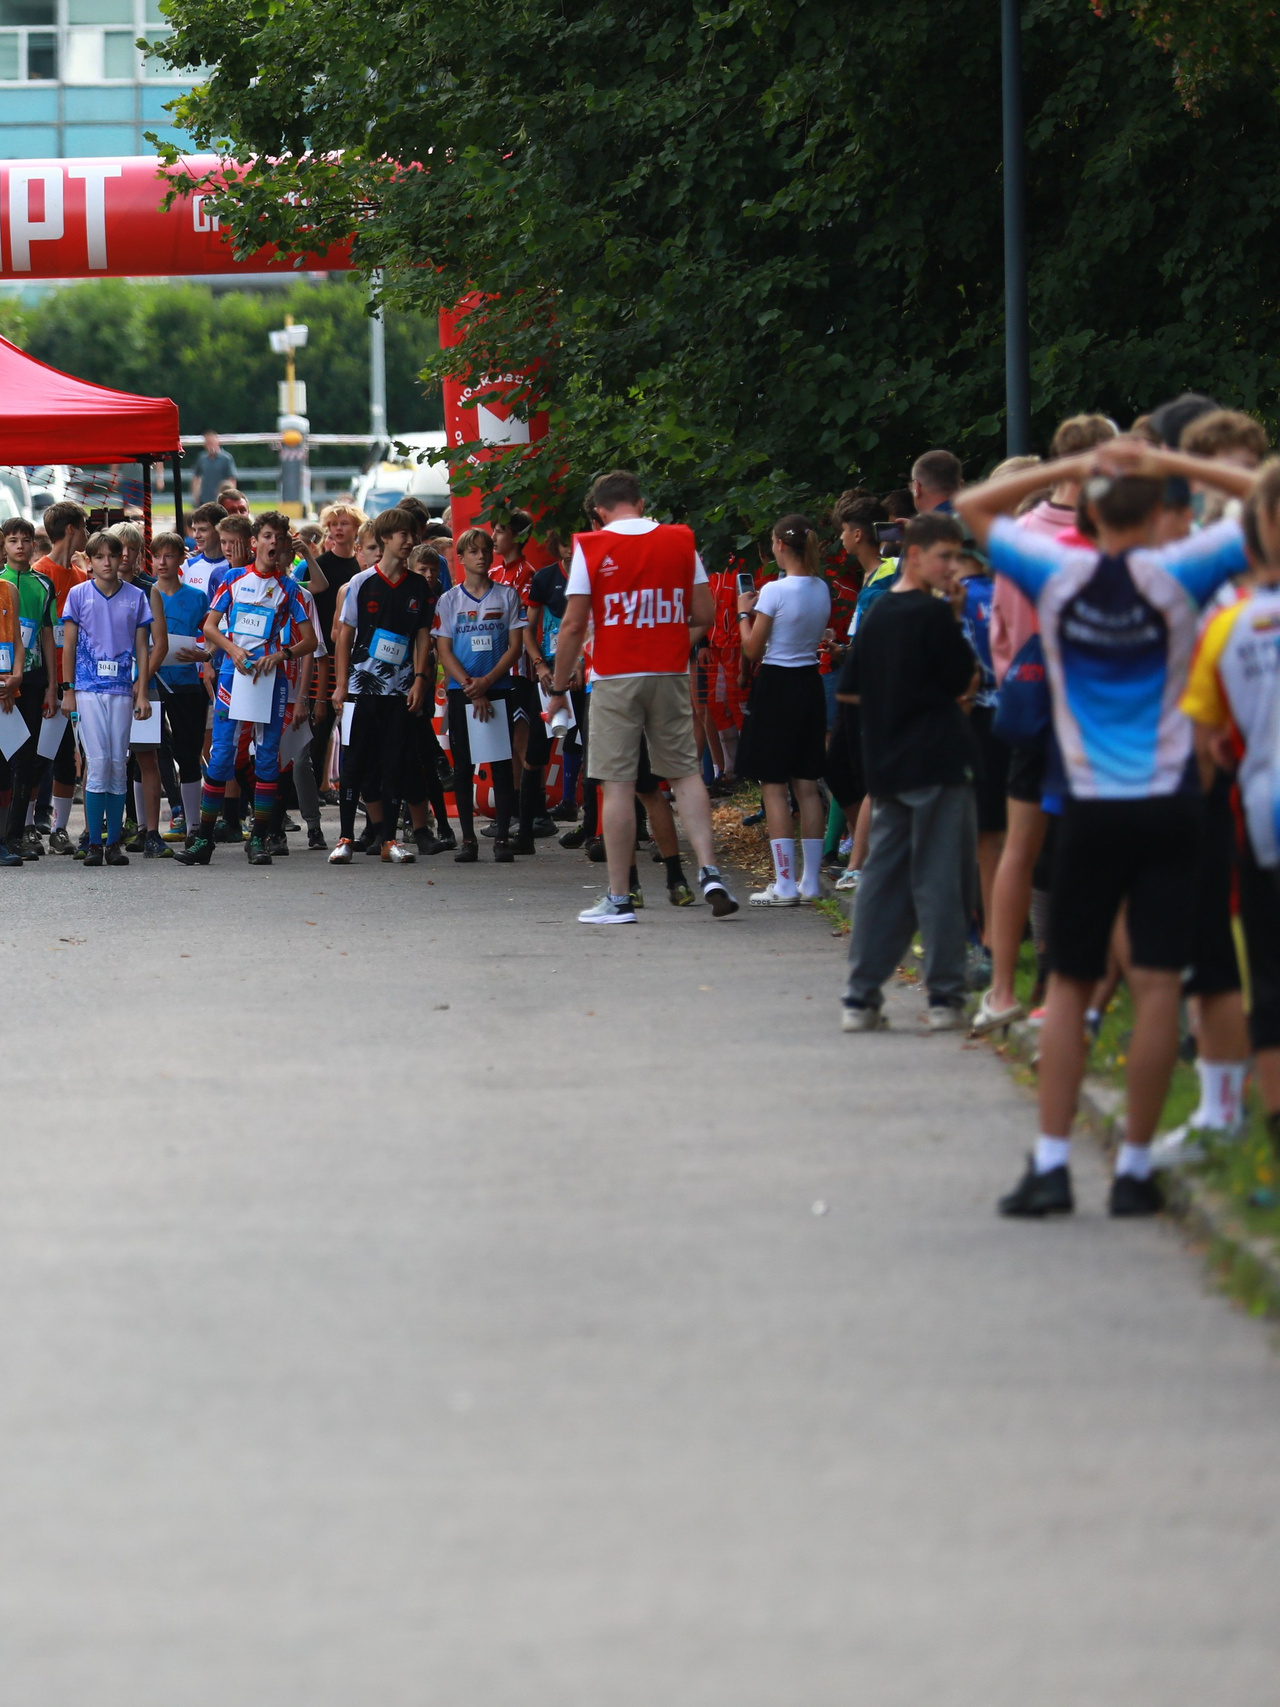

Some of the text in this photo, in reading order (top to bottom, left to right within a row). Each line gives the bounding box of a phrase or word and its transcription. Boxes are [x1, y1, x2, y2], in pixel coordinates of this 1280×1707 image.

[604, 588, 685, 629] СУДЬЯ
[242, 618, 260, 626] 303.1
[456, 622, 505, 634] KUZMOLOVO
[472, 638, 490, 646] 301.1
[381, 644, 400, 656] 302.1
